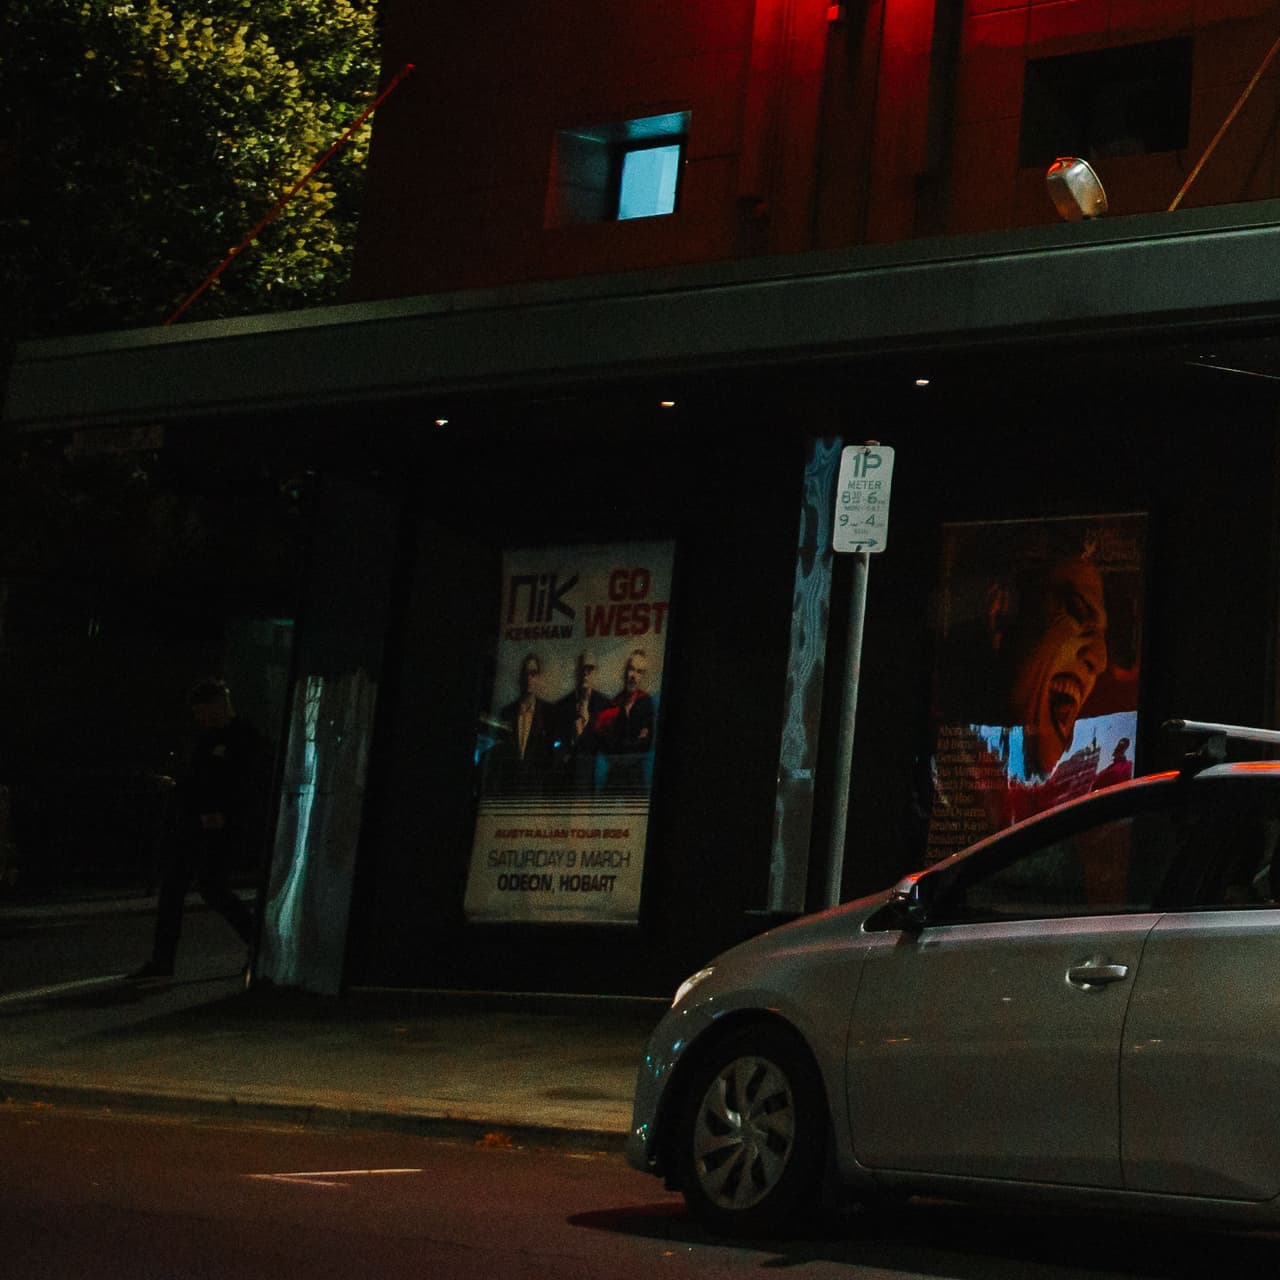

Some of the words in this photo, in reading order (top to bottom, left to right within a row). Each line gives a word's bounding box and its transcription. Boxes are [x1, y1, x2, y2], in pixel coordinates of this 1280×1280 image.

[853, 454, 881, 478] 1P
[848, 481, 881, 490] METER
[609, 568, 651, 601] GO
[584, 602, 670, 637] WEST
[505, 624, 573, 641] KERSHAW
[495, 828, 568, 839] AUSTRALIAN
[570, 828, 601, 839] TOUR
[487, 850, 563, 868] SATURDAY
[567, 850, 577, 867] 9
[580, 850, 630, 867] MARCH
[497, 874, 555, 894] ODEON,
[559, 874, 617, 893] HOBART
